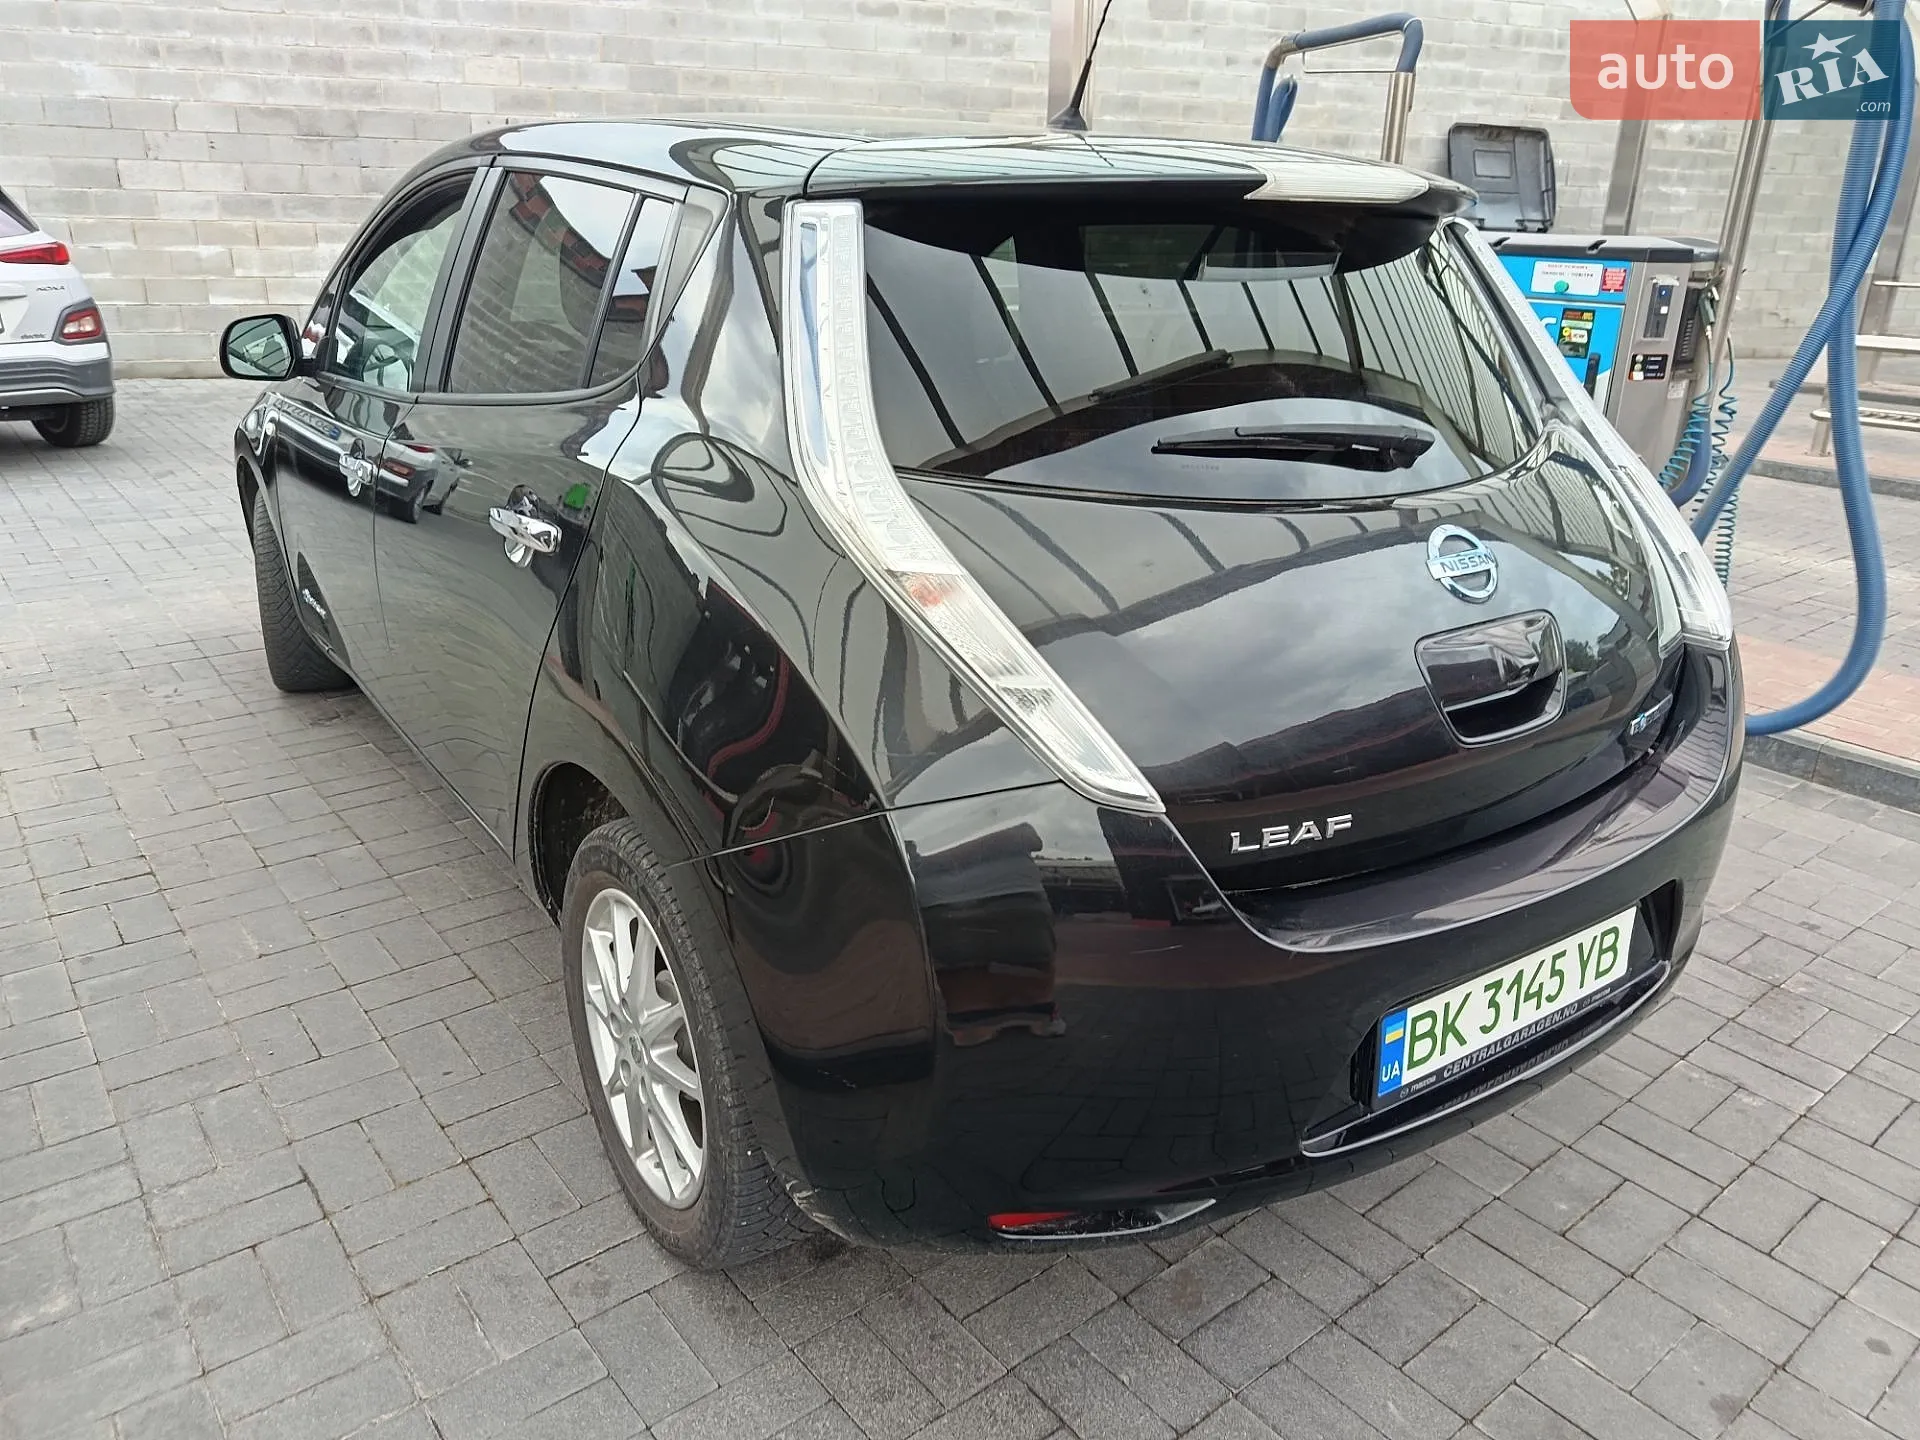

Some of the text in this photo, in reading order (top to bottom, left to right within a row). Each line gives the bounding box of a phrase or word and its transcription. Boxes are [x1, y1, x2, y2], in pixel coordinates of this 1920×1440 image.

[1439, 551, 1495, 573] NISSAN
[1230, 813, 1353, 854] LEAF
[1406, 925, 1621, 1072] BK 3145 YB
[1443, 1002, 1578, 1079] CENTRALGARAGEN.NO
[1381, 1059, 1401, 1083] UA
